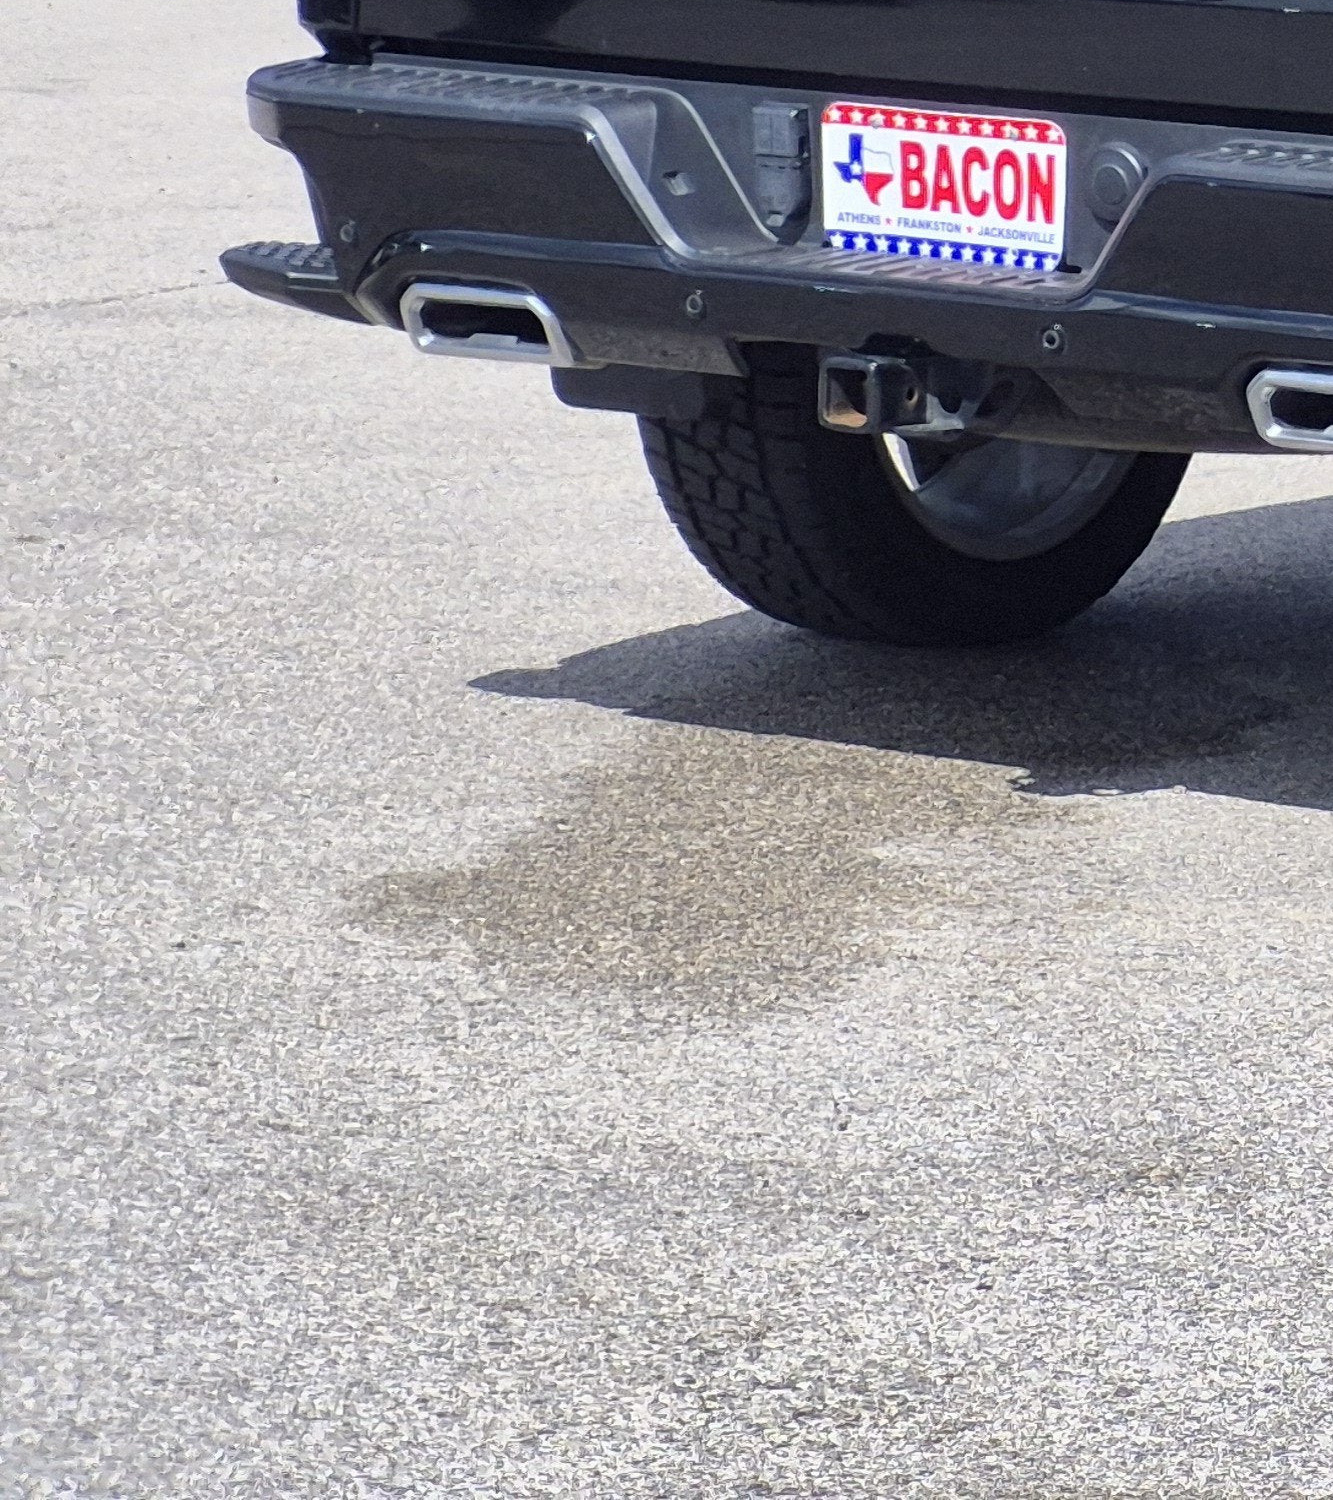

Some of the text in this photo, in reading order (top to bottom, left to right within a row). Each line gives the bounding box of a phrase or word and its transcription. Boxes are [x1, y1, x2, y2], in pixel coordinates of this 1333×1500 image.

[899, 139, 1057, 225] BACON
[837, 210, 1056, 244] ATHENS FRANKSTON JACKSONVILLE
